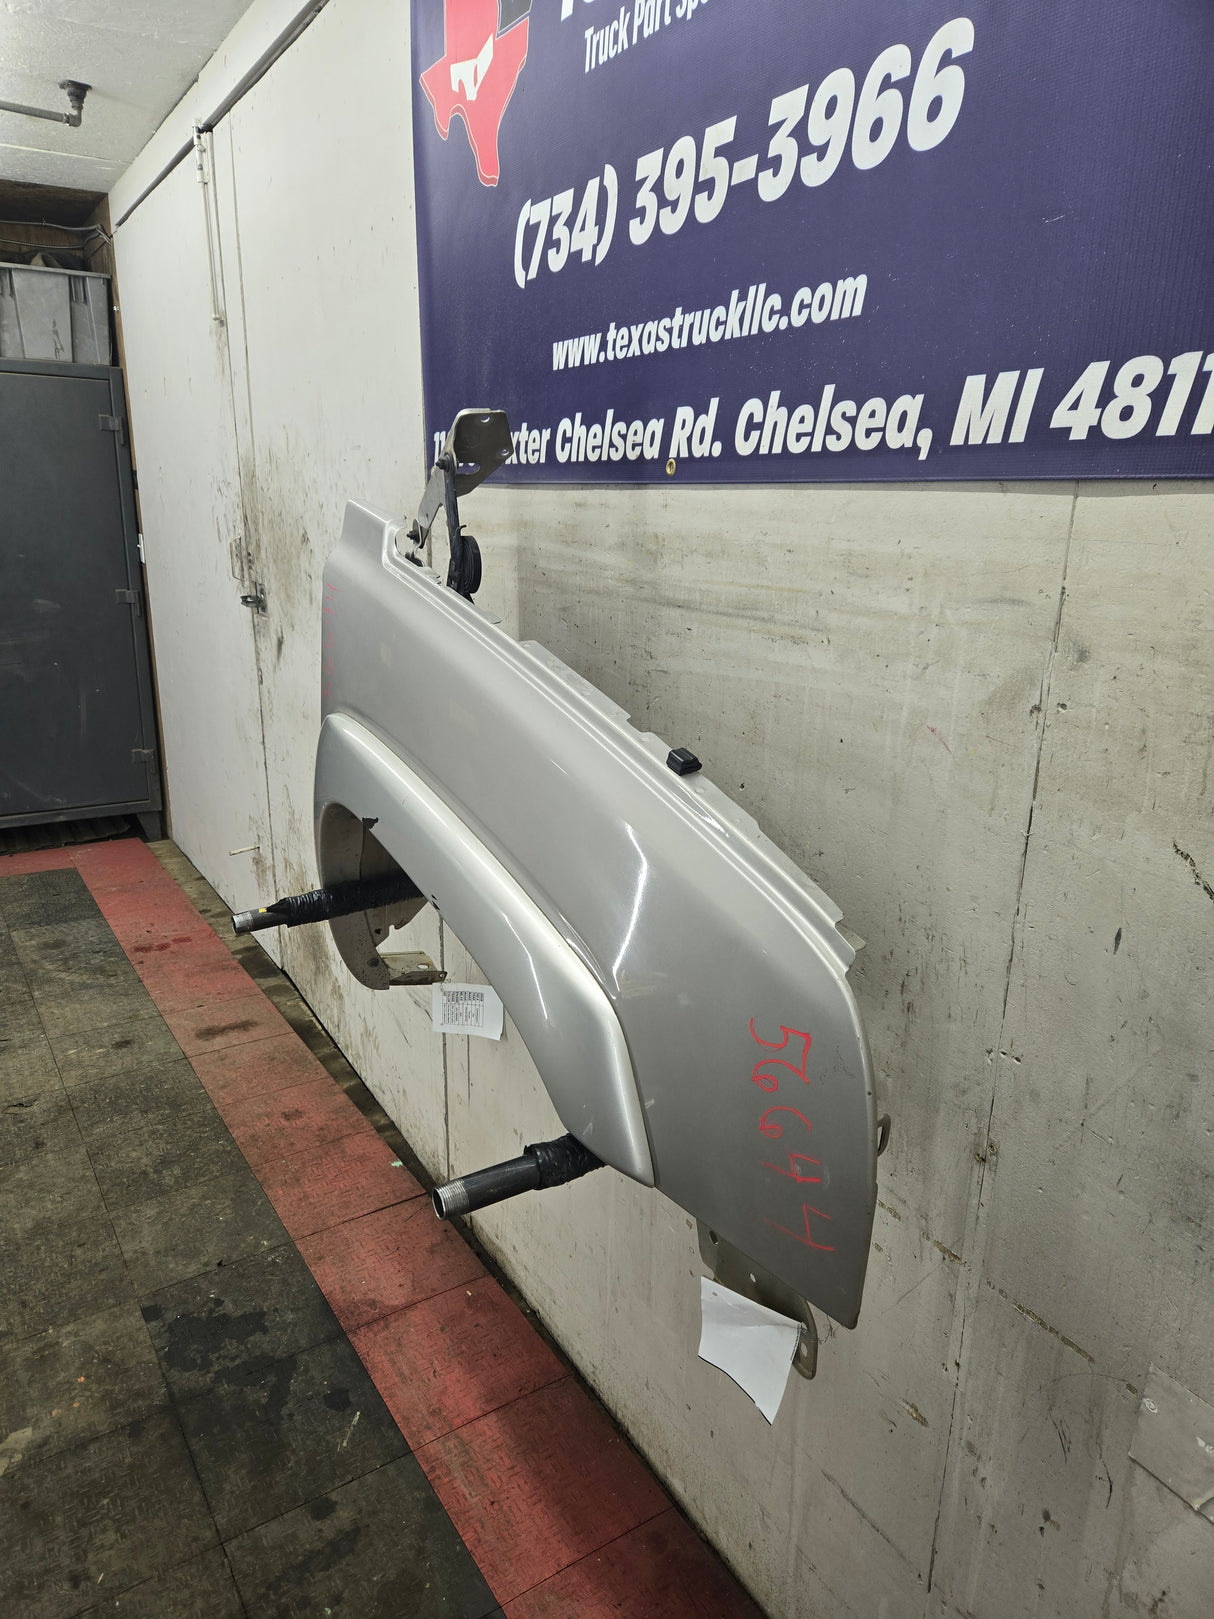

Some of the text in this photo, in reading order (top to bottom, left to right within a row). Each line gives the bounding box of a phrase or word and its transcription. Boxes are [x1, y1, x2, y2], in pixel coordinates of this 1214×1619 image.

[584, 6, 631, 74] Truck
[632, 0, 671, 45] Part
[514, 17, 975, 289] (734) 395-3966
[552, 274, 868, 371] www.texastruckllc.com
[504, 422, 551, 465] xter
[555, 409, 664, 463] Chelsea
[669, 397, 722, 459] Rd.
[735, 384, 933, 460] Chelsea,
[949, 368, 1044, 446] MI
[750, 1016, 836, 1251] 56644
